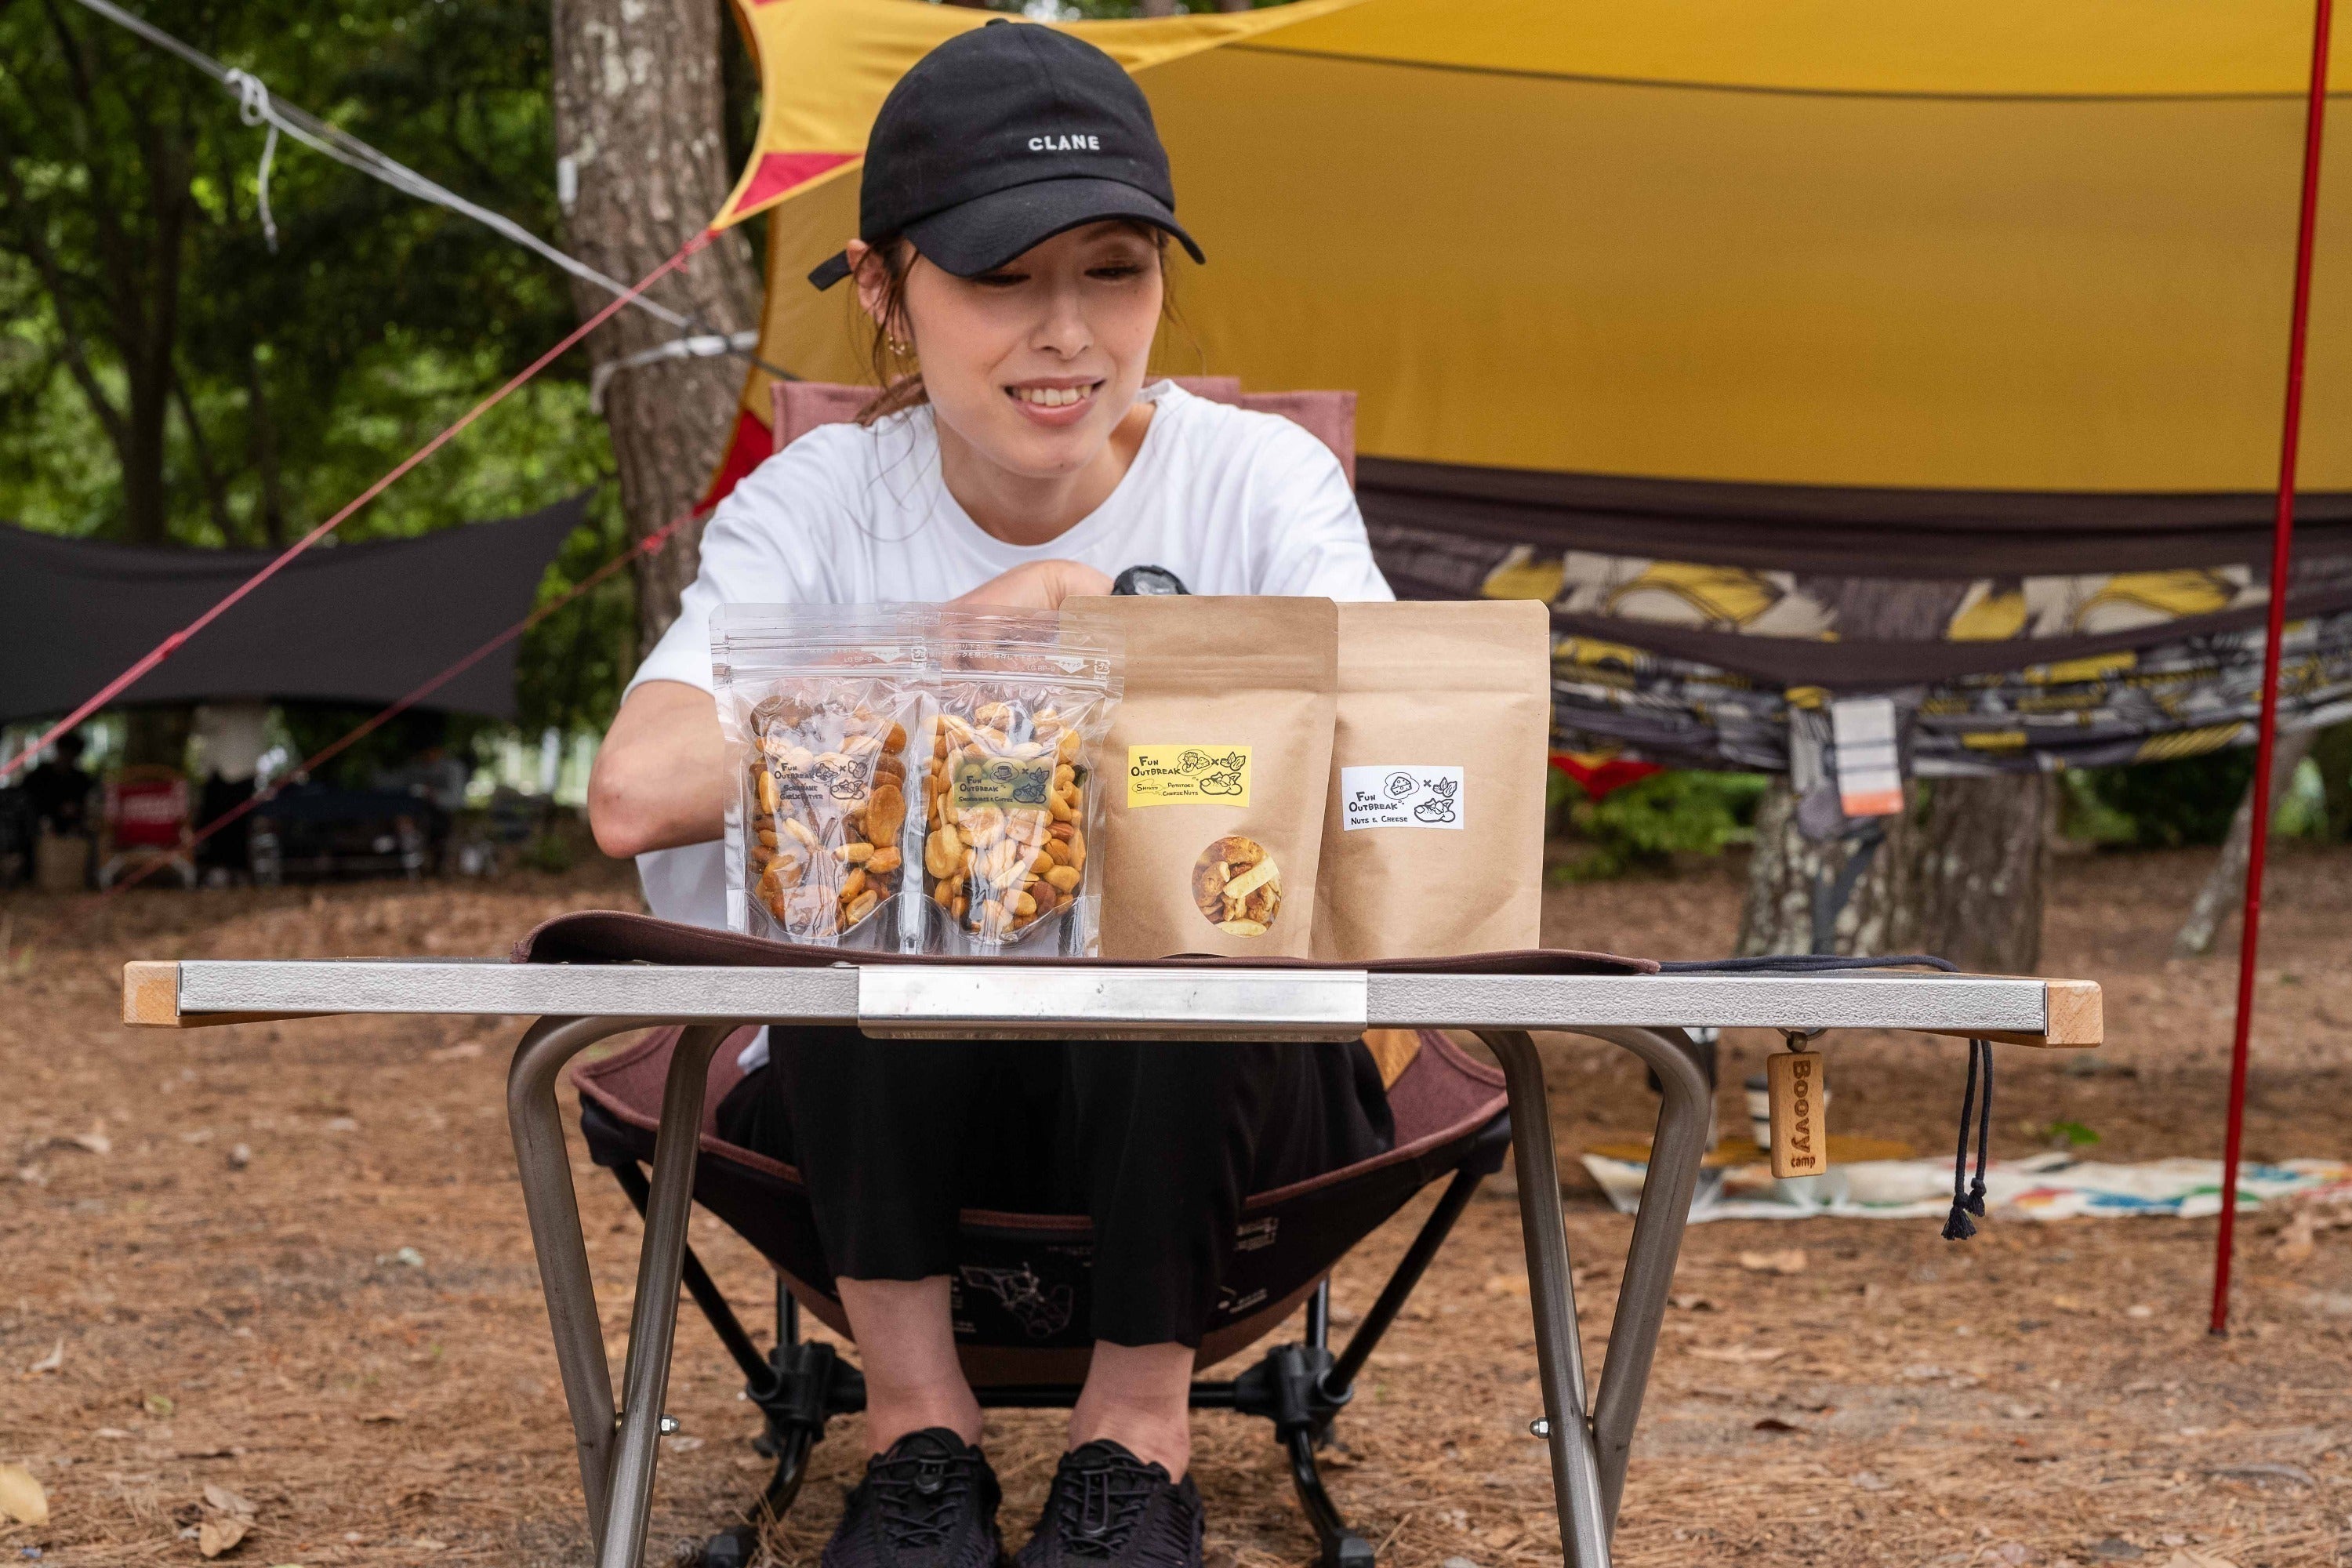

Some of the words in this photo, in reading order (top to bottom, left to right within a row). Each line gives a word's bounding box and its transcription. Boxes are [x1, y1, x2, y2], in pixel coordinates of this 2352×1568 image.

[1028, 134, 1100, 151] CLANE
[1139, 756, 1159, 767] FUN
[781, 763, 797, 771] FUN
[1131, 767, 1181, 776] OUTBREAK
[967, 775, 982, 784] FUN
[960, 783, 999, 792] OUTBREAK
[1356, 791, 1376, 802] FUN
[1348, 802, 1398, 812] OUTBREAK
[1791, 1156, 1816, 1169] camp
